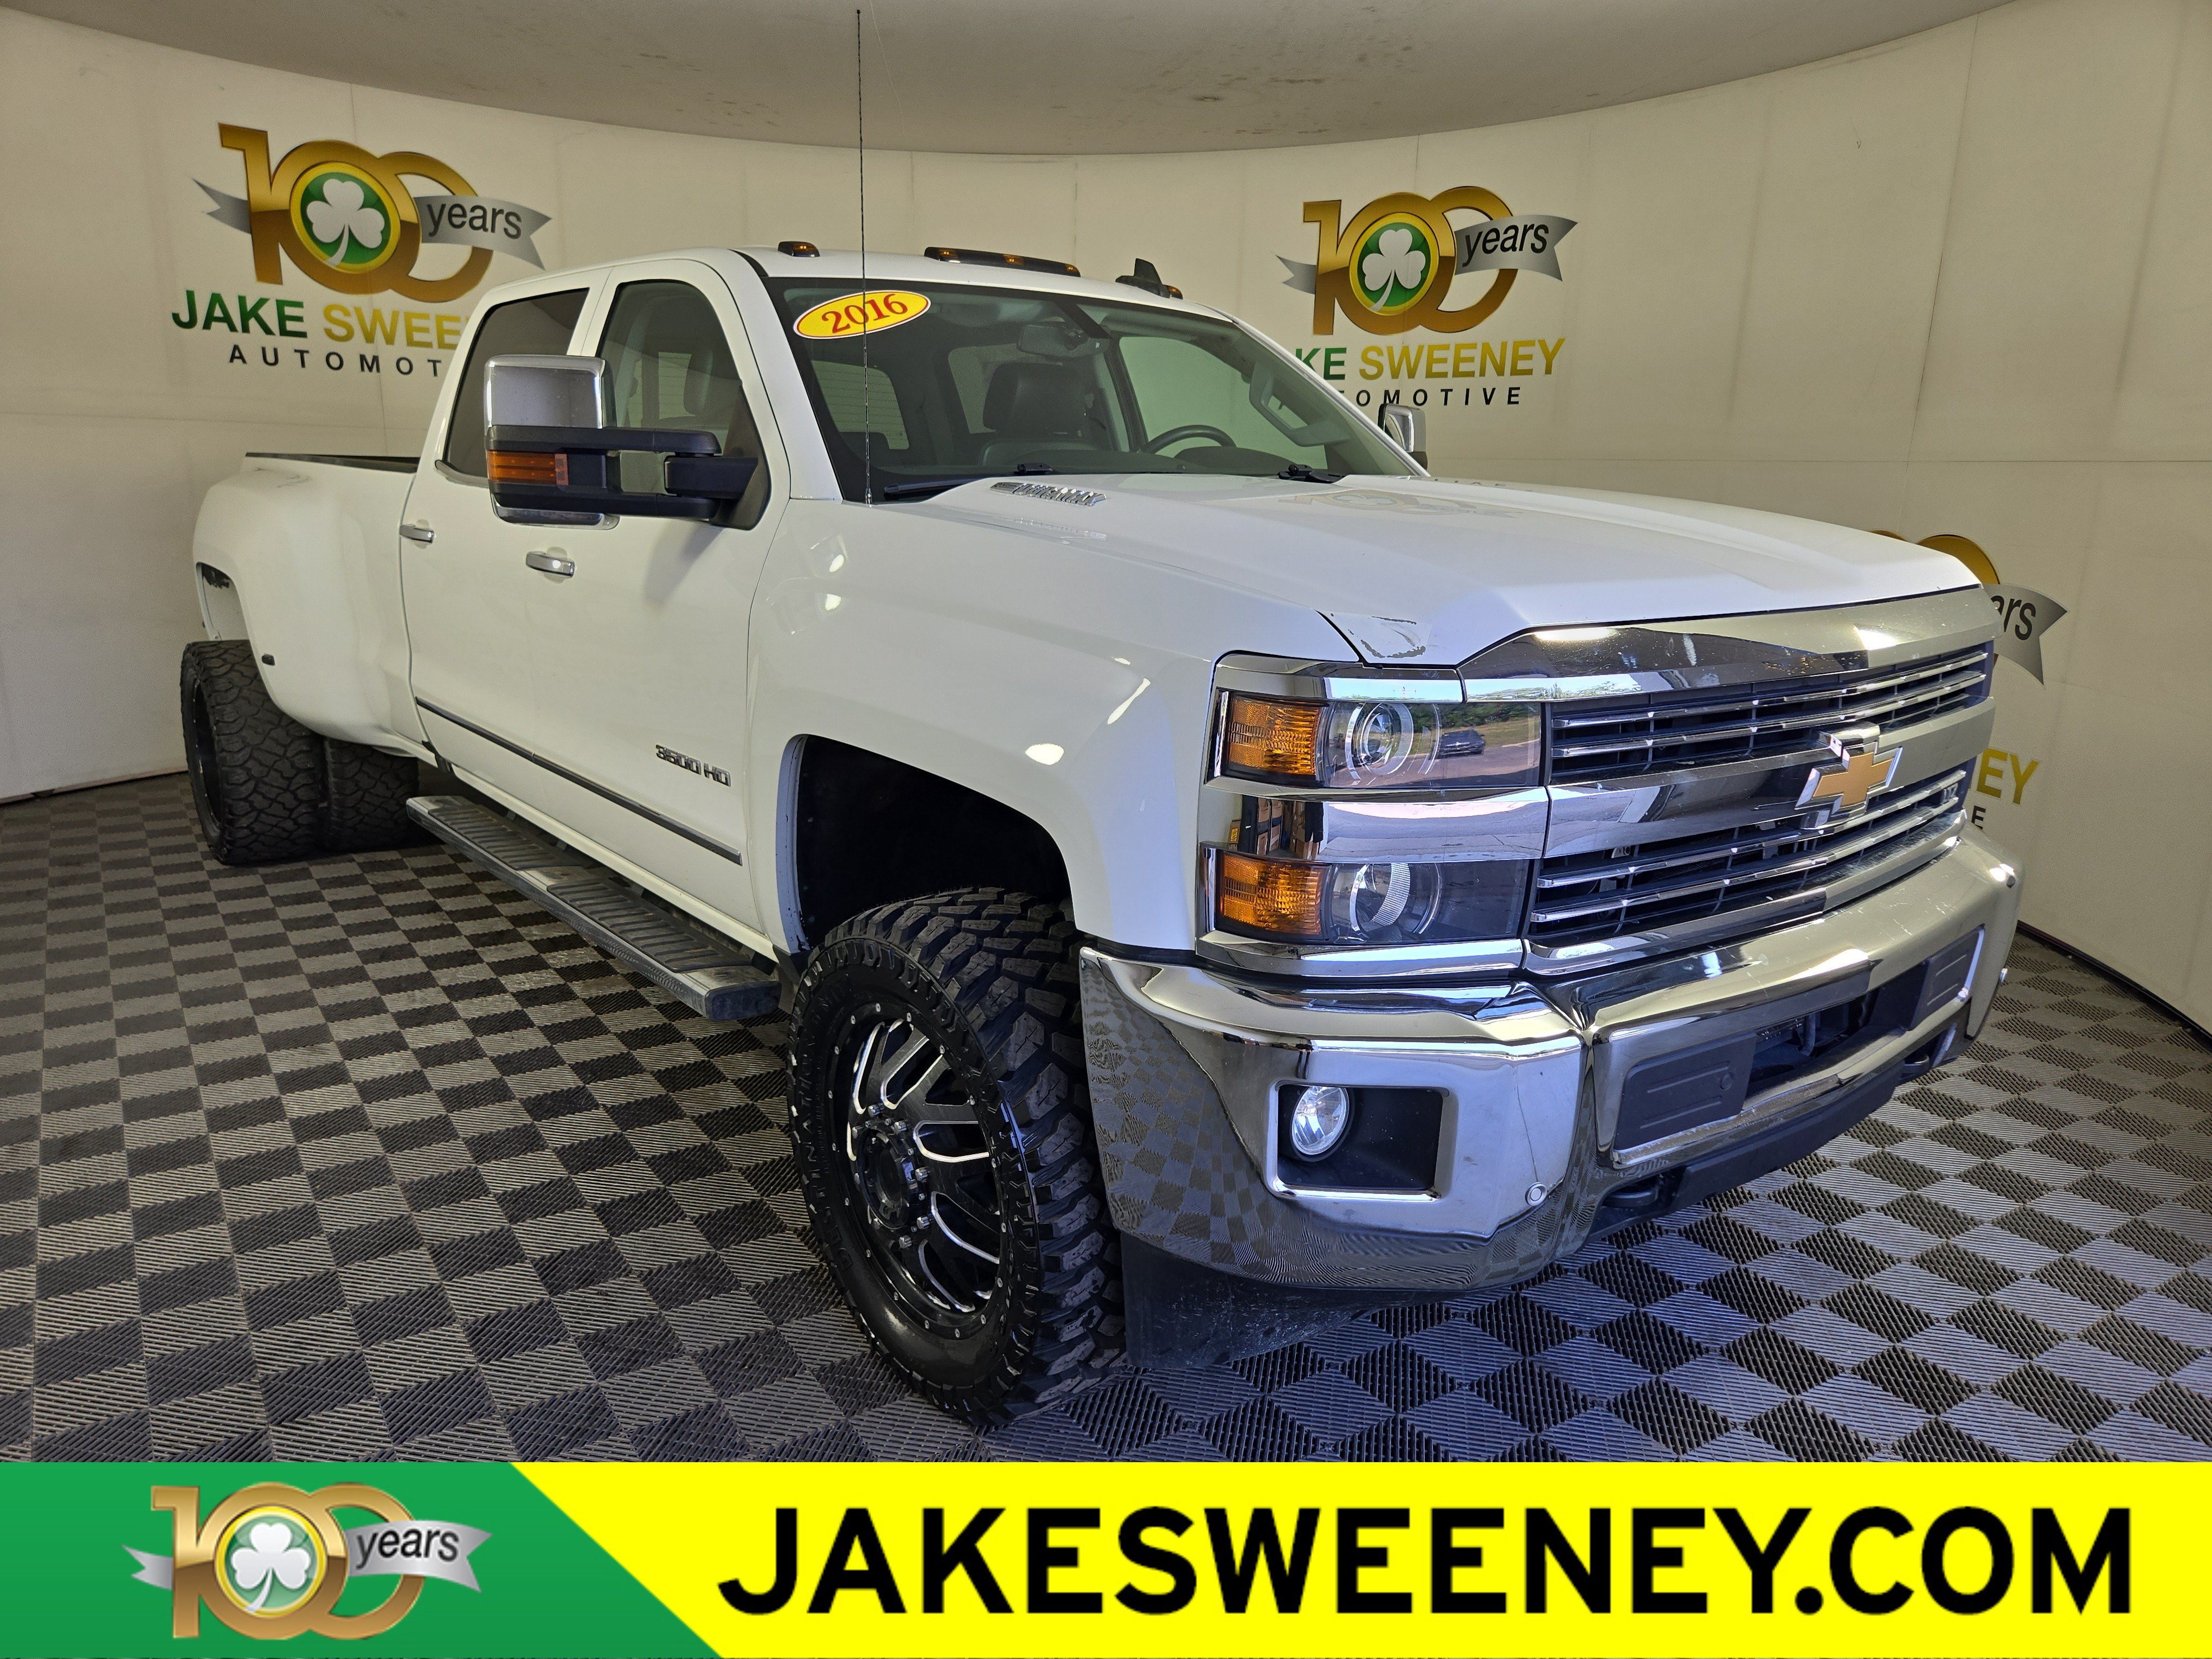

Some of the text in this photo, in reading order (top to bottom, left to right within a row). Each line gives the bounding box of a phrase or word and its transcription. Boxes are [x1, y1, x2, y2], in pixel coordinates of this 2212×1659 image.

[427, 201, 522, 239] years
[1462, 223, 1549, 268] years
[172, 290, 471, 350] JAKE SWEE
[821, 293, 908, 334] 2016
[229, 344, 442, 377] AUTOMOT
[1295, 338, 1566, 380] KE SWEENEY
[1338, 386, 1521, 407] OMOTIVE
